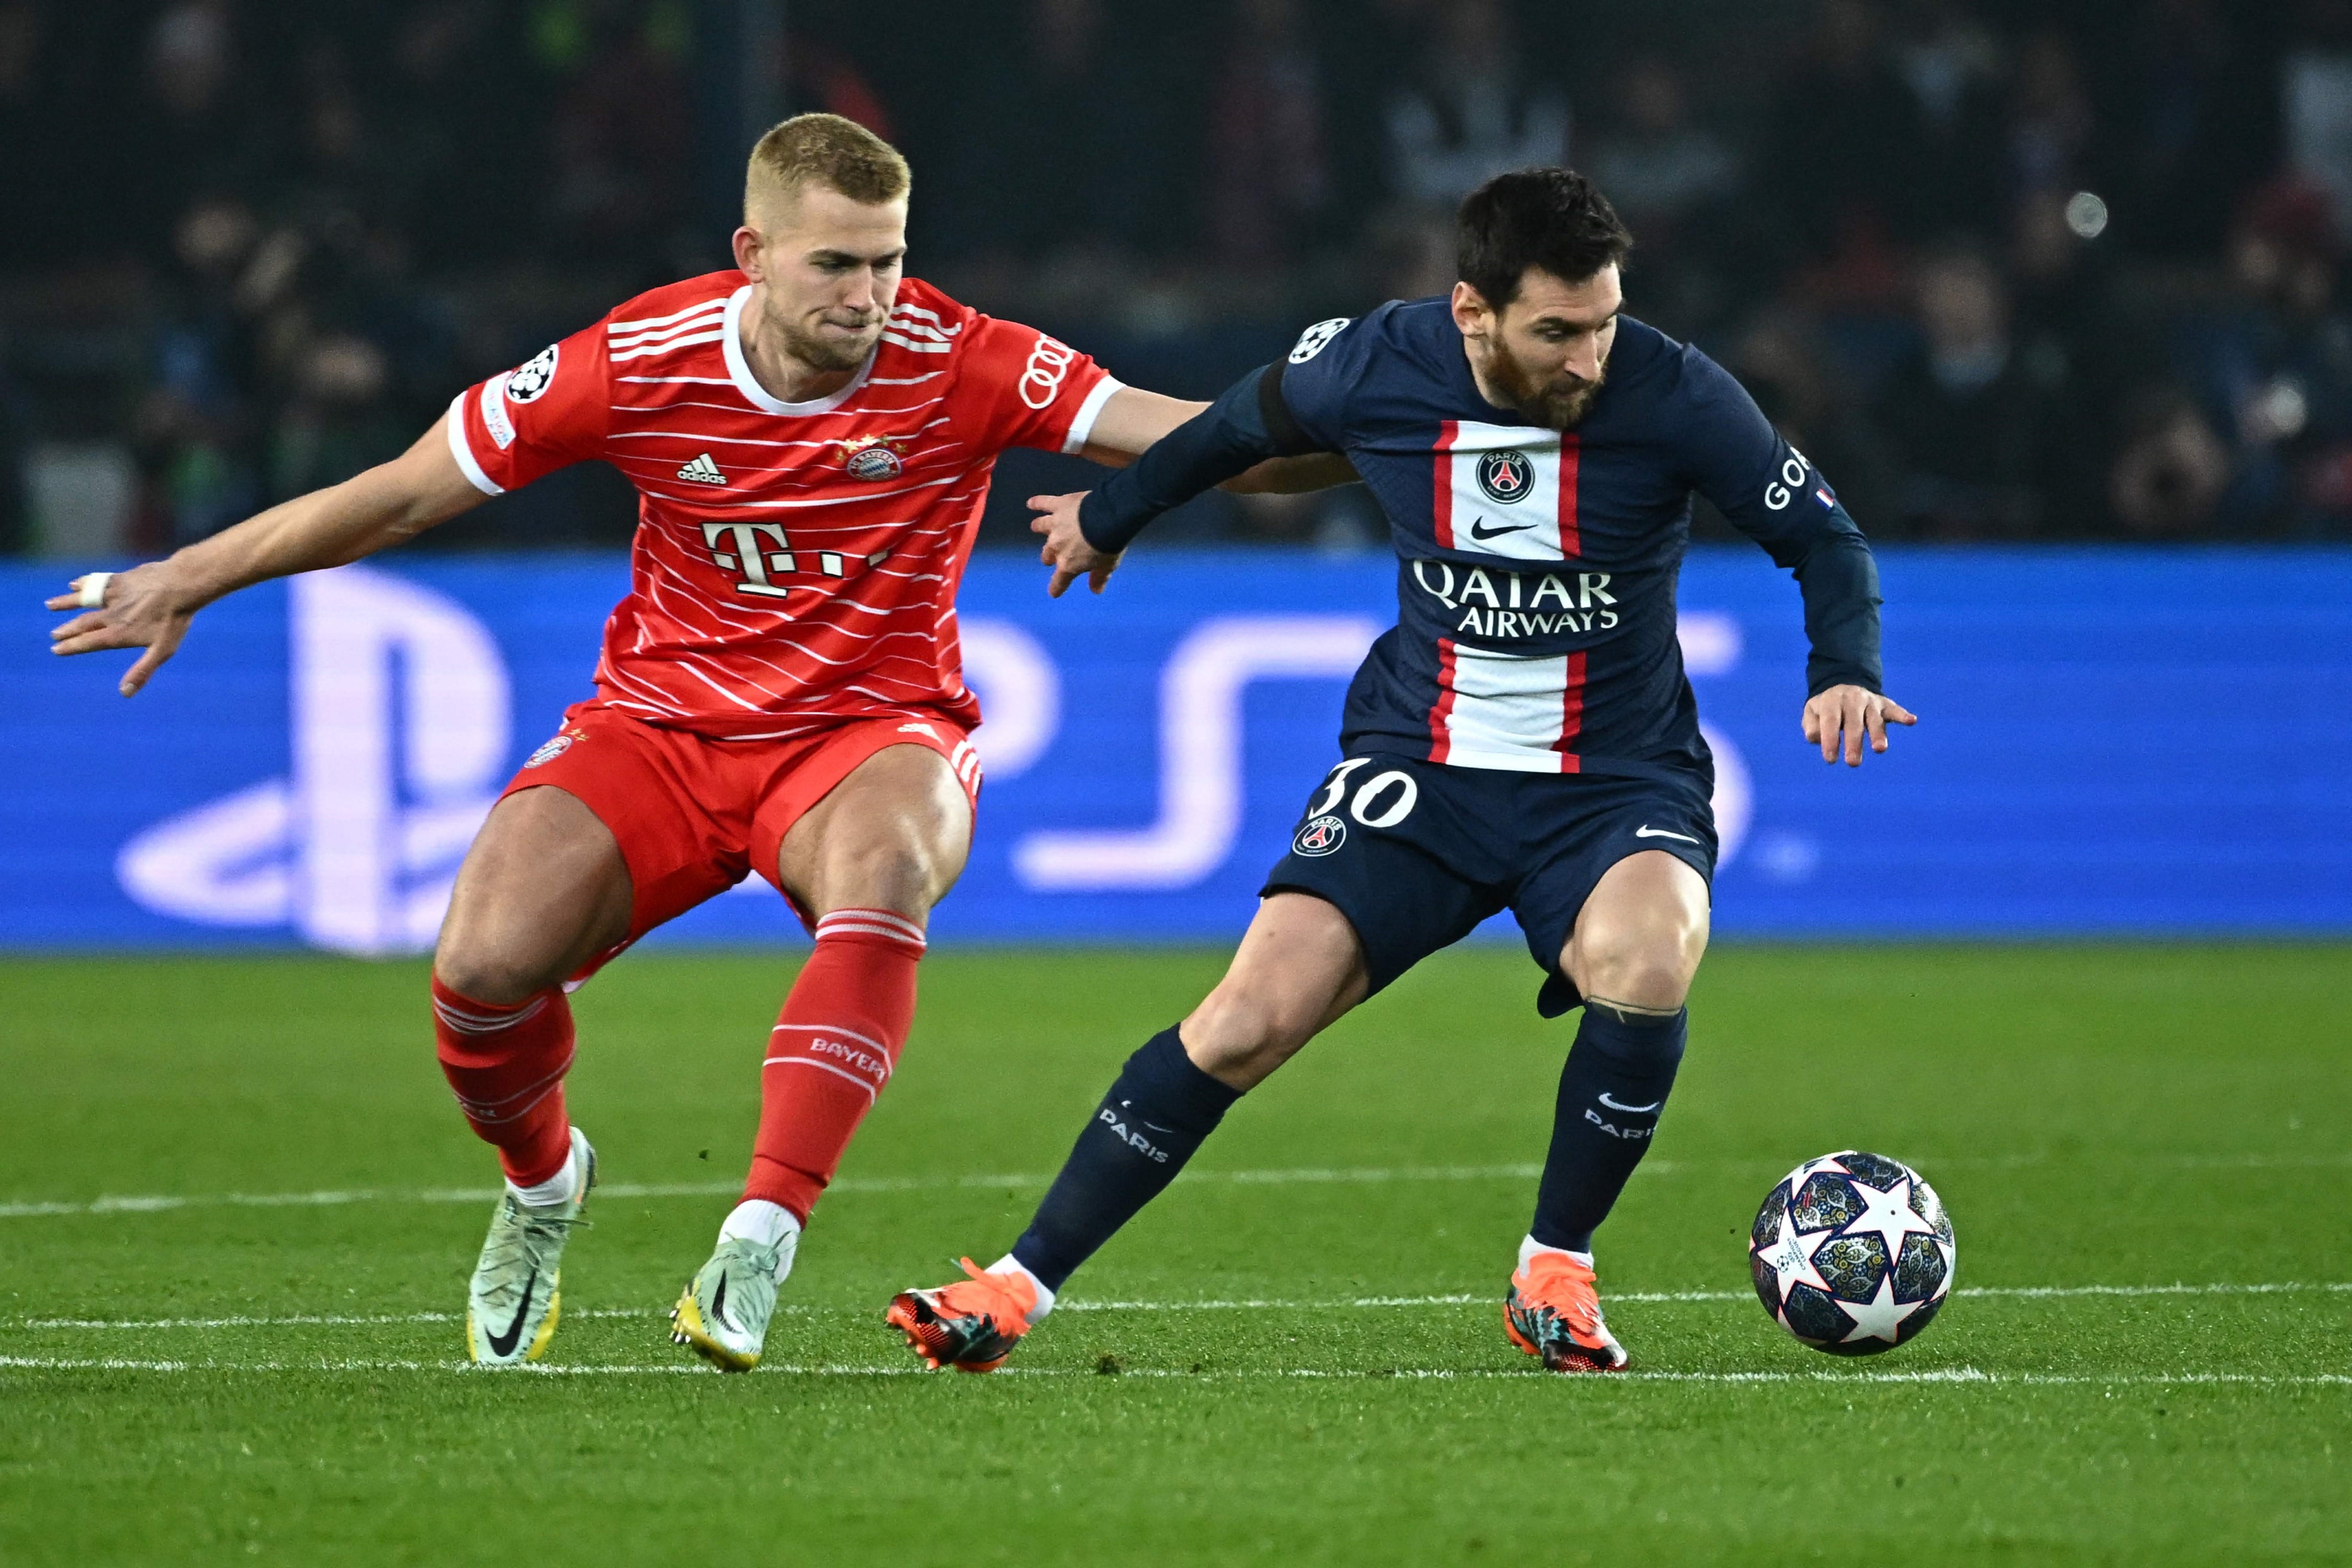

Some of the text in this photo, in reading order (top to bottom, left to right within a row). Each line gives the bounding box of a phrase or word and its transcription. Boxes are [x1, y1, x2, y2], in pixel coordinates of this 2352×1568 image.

[1488, 453, 1523, 465] PARIS
[676, 470, 728, 485] adidas
[1413, 560, 1618, 609] QATAR
[1457, 607, 1619, 637] AIRWAYS
[1308, 757, 1417, 827] 30
[1311, 819, 1342, 831] PARIS
[1100, 1109, 1168, 1163] PARIS
[1585, 1109, 1659, 1139] PARI
